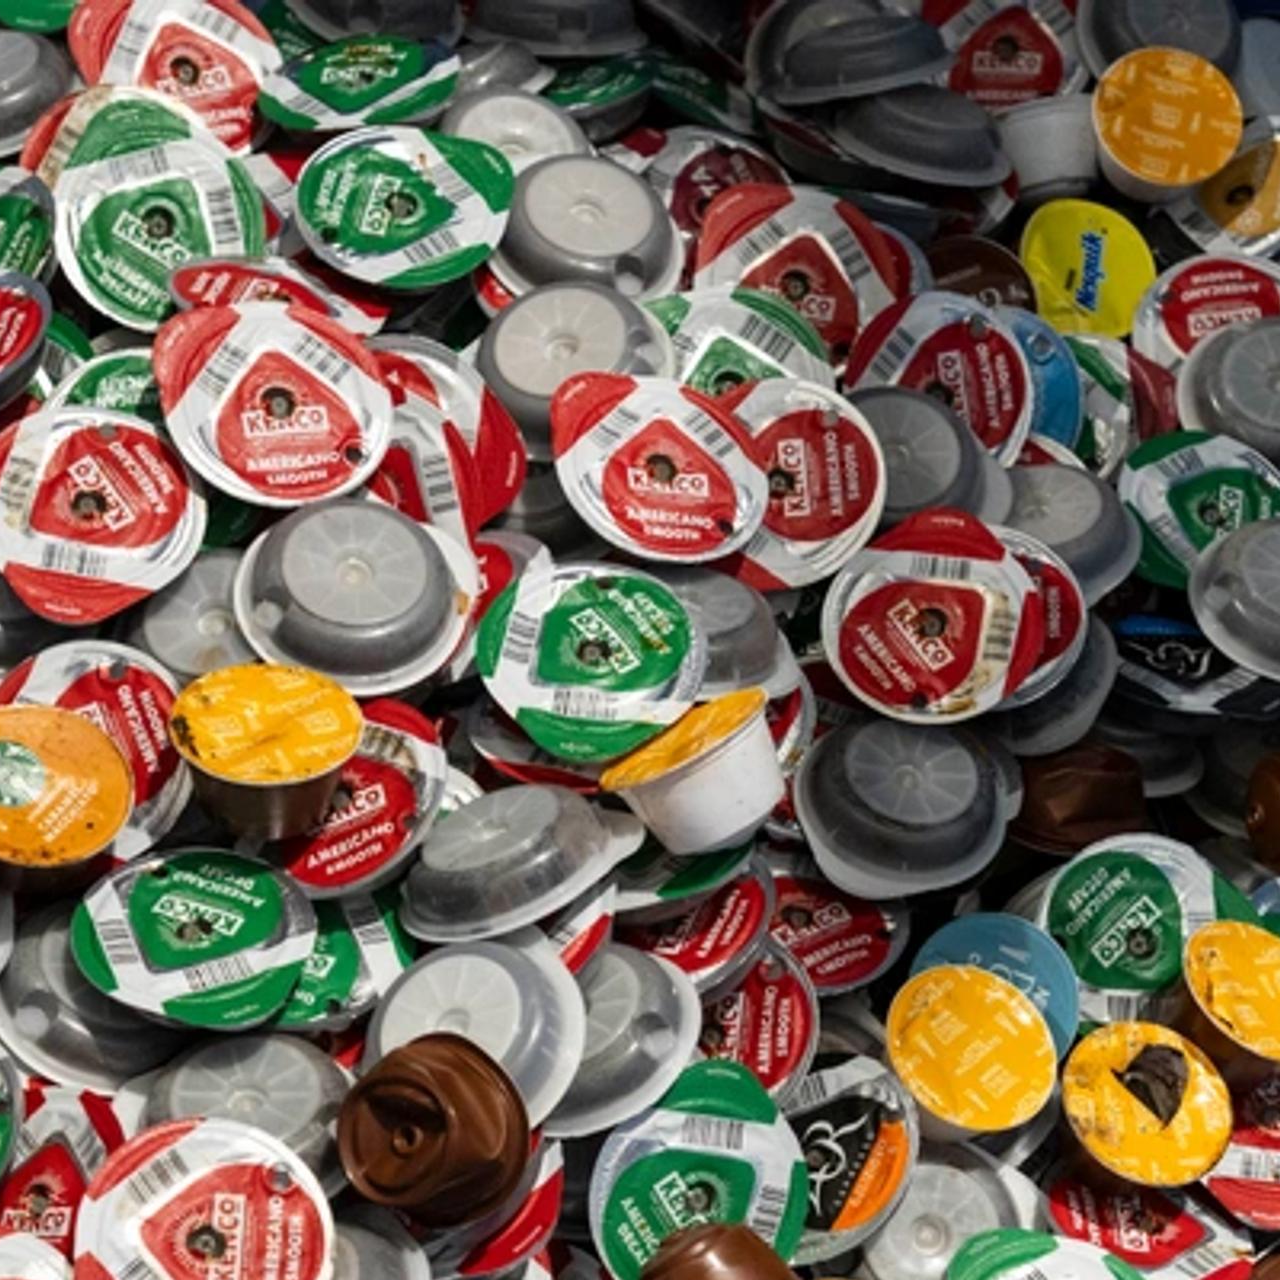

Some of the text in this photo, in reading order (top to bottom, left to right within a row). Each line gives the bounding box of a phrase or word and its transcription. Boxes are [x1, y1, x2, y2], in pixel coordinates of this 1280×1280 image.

[1183, 282, 1259, 302] AMERICANO
[1192, 270, 1243, 284] SMOOTH
[976, 343, 999, 428] AMERICANO
[996, 355, 1011, 411] SMOOTH
[247, 452, 338, 472] AMERICANO
[268, 470, 326, 484] SMOOTH
[119, 686, 159, 773] AMERICANO
[141, 690, 167, 749] SMOOTH
[308, 822, 393, 868] AMERICANO
[328, 842, 381, 874] SMOOTH
[174, 871, 263, 905] AMERICANO
[1066, 870, 1132, 934] AMERICANO
[1068, 868, 1108, 909] DECAFF
[759, 986, 777, 1072] AMERICANO
[779, 998, 790, 1055] SMOOTH
